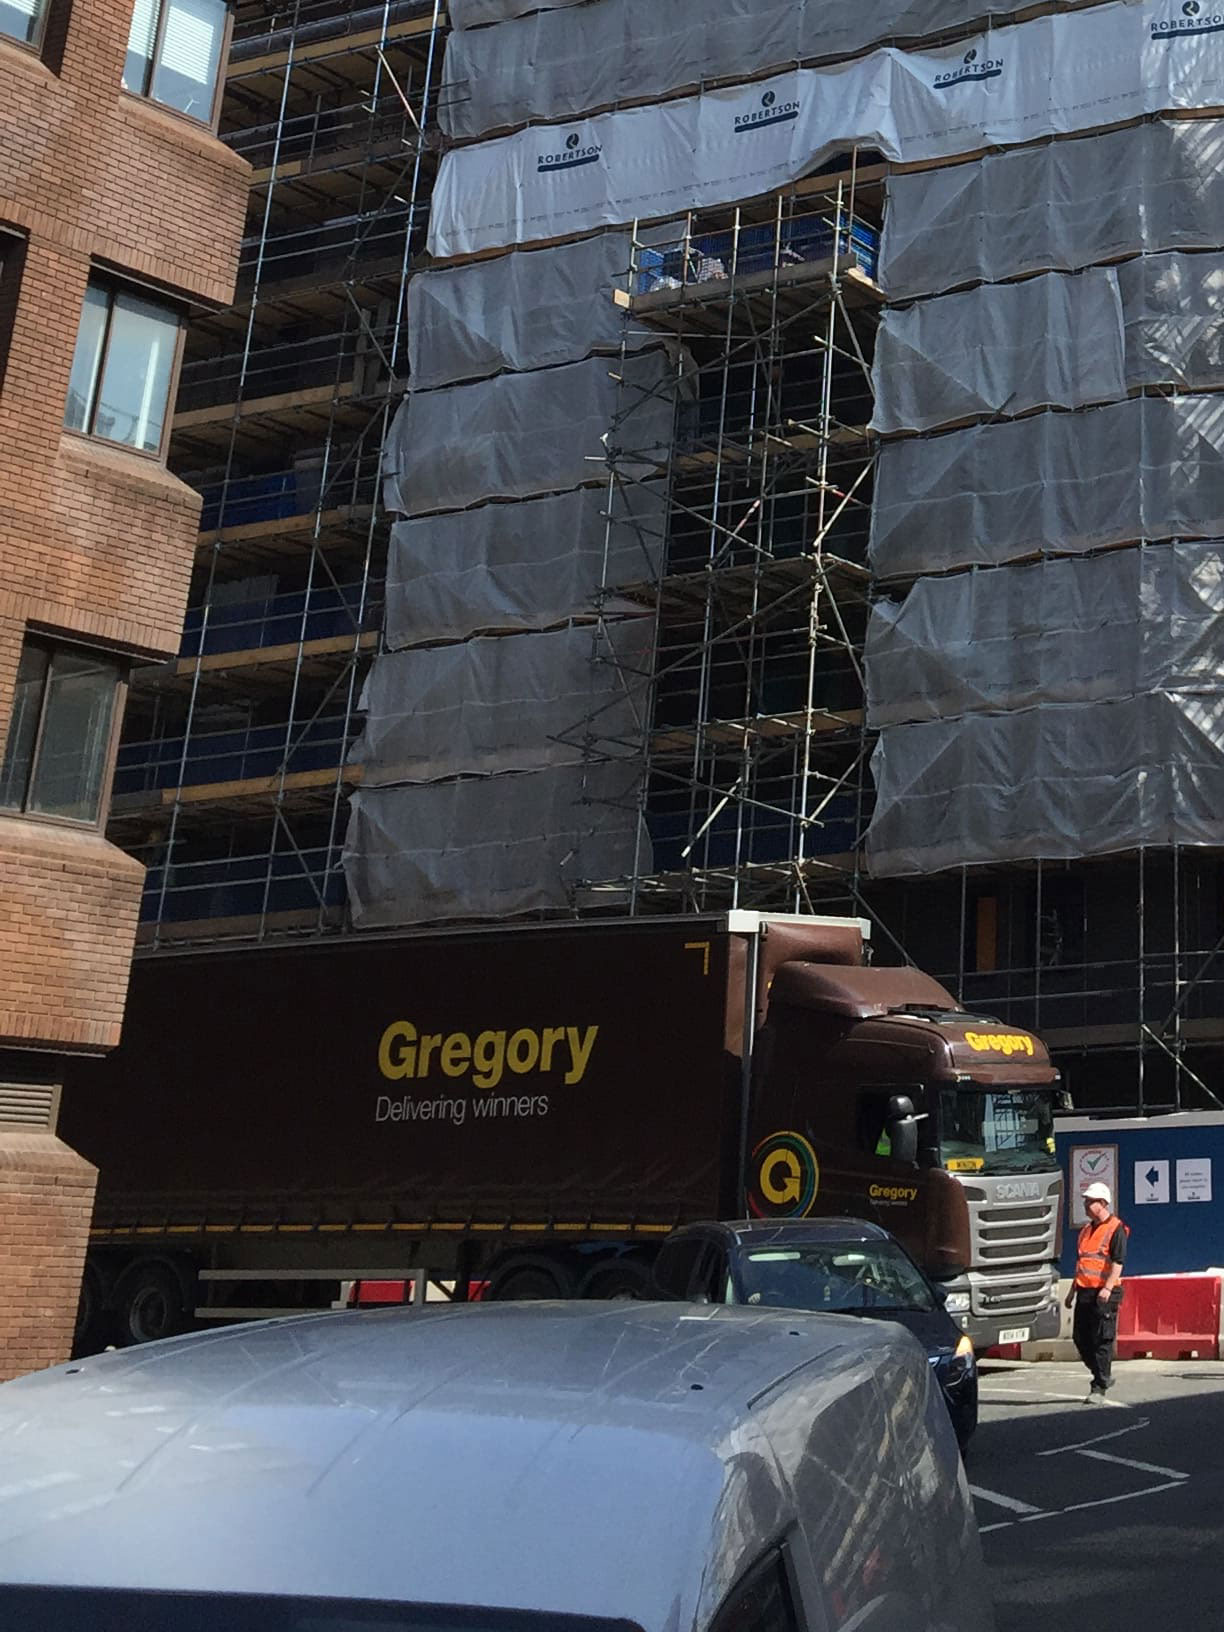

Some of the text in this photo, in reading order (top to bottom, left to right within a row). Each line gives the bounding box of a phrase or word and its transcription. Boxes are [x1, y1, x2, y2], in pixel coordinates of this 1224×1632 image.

[934, 59, 1004, 82] ROBERTSON
[734, 100, 800, 125] ROBERTSON
[537, 144, 602, 165] ROBERTSON
[378, 1020, 599, 1088] Gregory
[965, 1032, 1033, 1055] Gregory
[375, 1092, 549, 1126] Delivering winners
[869, 1184, 917, 1201] Gregory
[996, 1182, 1040, 1200] SCANIA
